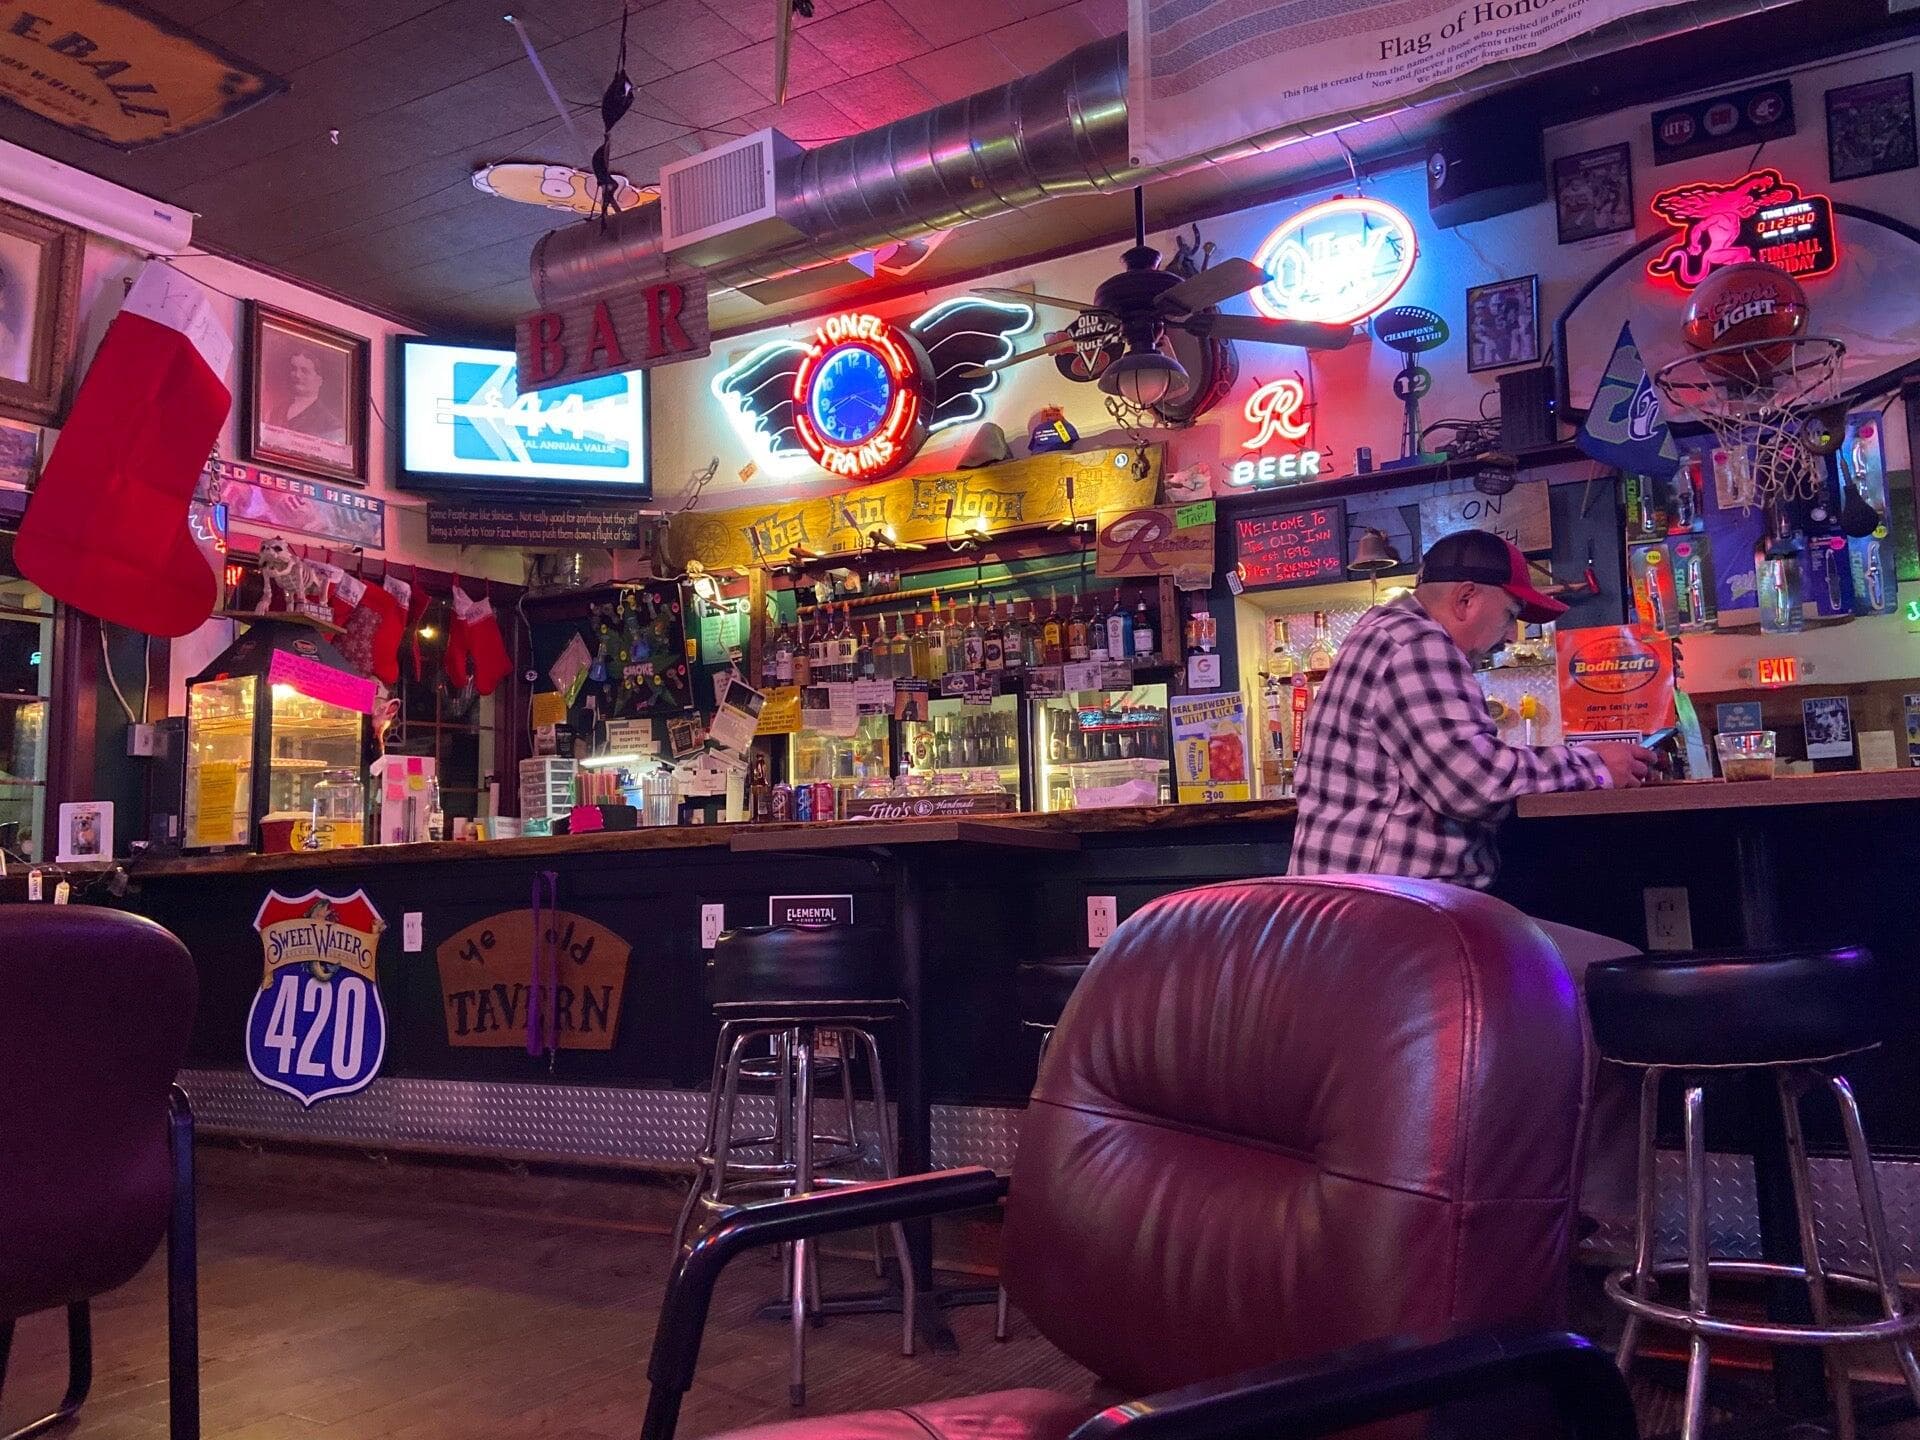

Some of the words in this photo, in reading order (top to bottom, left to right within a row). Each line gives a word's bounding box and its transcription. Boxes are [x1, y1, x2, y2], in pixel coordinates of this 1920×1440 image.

[1379, 32, 1432, 60] Flag
[1441, 11, 1467, 39] of
[1473, 0, 1557, 25] Hono
[1283, 91, 1301, 99] This
[1303, 84, 1319, 94] flag
[1331, 73, 1363, 87] created
[1366, 69, 1388, 80] from
[1390, 65, 1404, 74] the
[1407, 53, 1434, 69] names
[1436, 49, 1446, 58] of
[1447, 38, 1471, 54] those
[1473, 29, 1493, 41] who
[1495, 17, 1538, 37] perished
[1540, 15, 1550, 25] in
[1551, 6, 1566, 19] the
[1371, 79, 1392, 89] Now
[1395, 72, 1412, 82] and
[1413, 60, 1443, 77] forever
[1448, 54, 1454, 63] it
[1455, 38, 1502, 60] represents
[1504, 32, 1528, 45] their
[1530, 9, 1583, 39] immortality
[1416, 73, 1431, 84] We
[1432, 65, 1453, 78] shall
[1455, 56, 1479, 71] never
[1481, 46, 1510, 63] forget
[1512, 40, 1537, 53] them
[1664, 119, 1691, 137] LET'S
[1759, 238, 1823, 262] FIREBALL
[1078, 314, 1099, 328] OLD
[1713, 299, 1777, 341] LIGHT
[527, 282, 692, 385] BAR
[808, 312, 883, 358] LIONEL
[1383, 325, 1435, 342] CHAMPIONS
[1415, 331, 1442, 343] XLVIII
[834, 361, 844, 376] 11
[848, 352, 860, 366] 12
[865, 354, 871, 369] 1
[878, 365, 887, 379] 2
[821, 377, 835, 392] 10
[881, 383, 889, 398] 3
[1397, 374, 1428, 395] 12
[820, 396, 831, 408] 9
[827, 417, 837, 430] 8
[1241, 378, 1313, 450] R
[838, 426, 847, 440] 7
[852, 427, 863, 440] 6
[540, 441, 583, 452] ANNUAL
[584, 444, 616, 454] VALUE
[820, 436, 894, 474] TRAINS
[1232, 450, 1321, 485] BEER
[259, 473, 316, 497] BEER
[326, 489, 378, 512] HERE
[913, 478, 1026, 522] Saloon
[431, 508, 447, 520] Some
[448, 508, 468, 522] People
[469, 512, 479, 520] are
[480, 508, 491, 520] like
[520, 511, 532, 522] Not
[533, 509, 548, 525] really
[550, 510, 566, 525] good
[567, 510, 576, 522] for
[576, 511, 601, 527] anything
[603, 511, 613, 524] but
[614, 512, 627, 527] they
[1238, 515, 1306, 538] WELCOME
[1311, 510, 1326, 526] TO
[454, 524, 470, 537] Smile
[471, 527, 480, 537] to
[481, 526, 495, 538] Your
[497, 527, 511, 538] Face
[512, 525, 529, 540] when
[530, 530, 541, 542] you
[543, 526, 557, 542] push
[558, 526, 574, 540] them
[575, 527, 592, 541] down
[614, 526, 622, 540] of
[748, 512, 805, 560] The
[1270, 533, 1299, 548] OLD
[1301, 529, 1331, 543] INN
[1275, 558, 1321, 573] FRIENDLY
[1574, 657, 1655, 674] Bodhizafa
[1759, 658, 1795, 683] EXIT
[1172, 703, 1192, 714] REAL
[1193, 698, 1226, 712] BREWED
[1228, 695, 1242, 706] TEA
[1586, 704, 1607, 712] darn
[1609, 703, 1632, 711] tasty
[1182, 711, 1205, 726] WITH
[1188, 742, 1198, 754] TEA
[1188, 754, 1199, 781] TWISTED
[868, 801, 911, 818] Tito's
[936, 798, 975, 811] Handmade
[941, 808, 970, 816] VODKA
[786, 907, 837, 922] ELEMENTAL
[459, 930, 496, 965] ye
[545, 921, 595, 965] old
[263, 974, 367, 1081] 420
